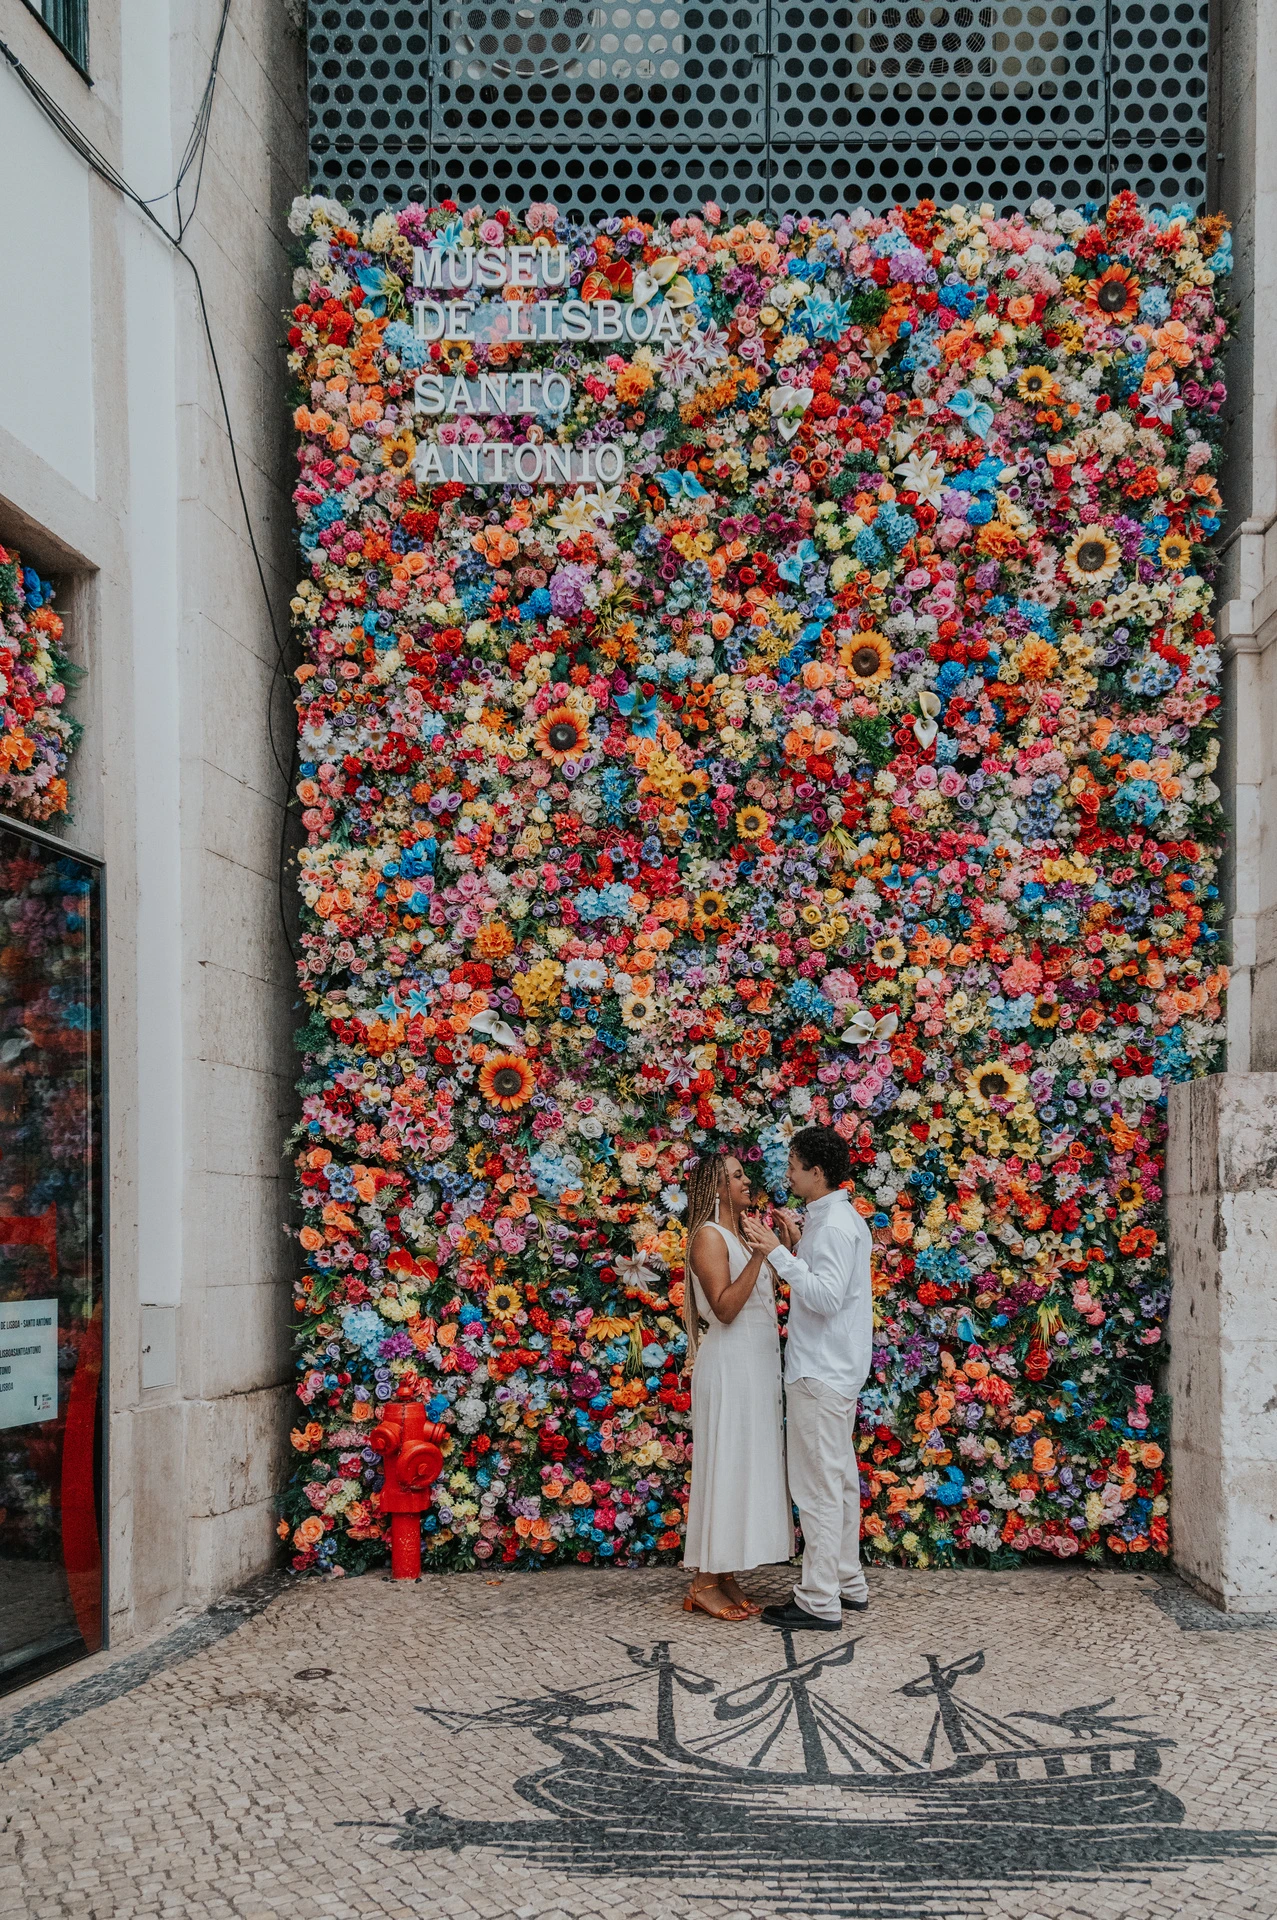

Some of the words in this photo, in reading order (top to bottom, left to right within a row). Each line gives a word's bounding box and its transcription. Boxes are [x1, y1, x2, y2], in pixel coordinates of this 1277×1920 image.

[413, 245, 569, 289] MUSEU
[414, 300, 475, 342] DE
[506, 299, 682, 342] LISBOA
[414, 372, 571, 415] SANTO
[417, 433, 623, 483] ANTÓNIO
[7, 1319, 20, 1330] LISBOA
[23, 1318, 35, 1328] SANTO
